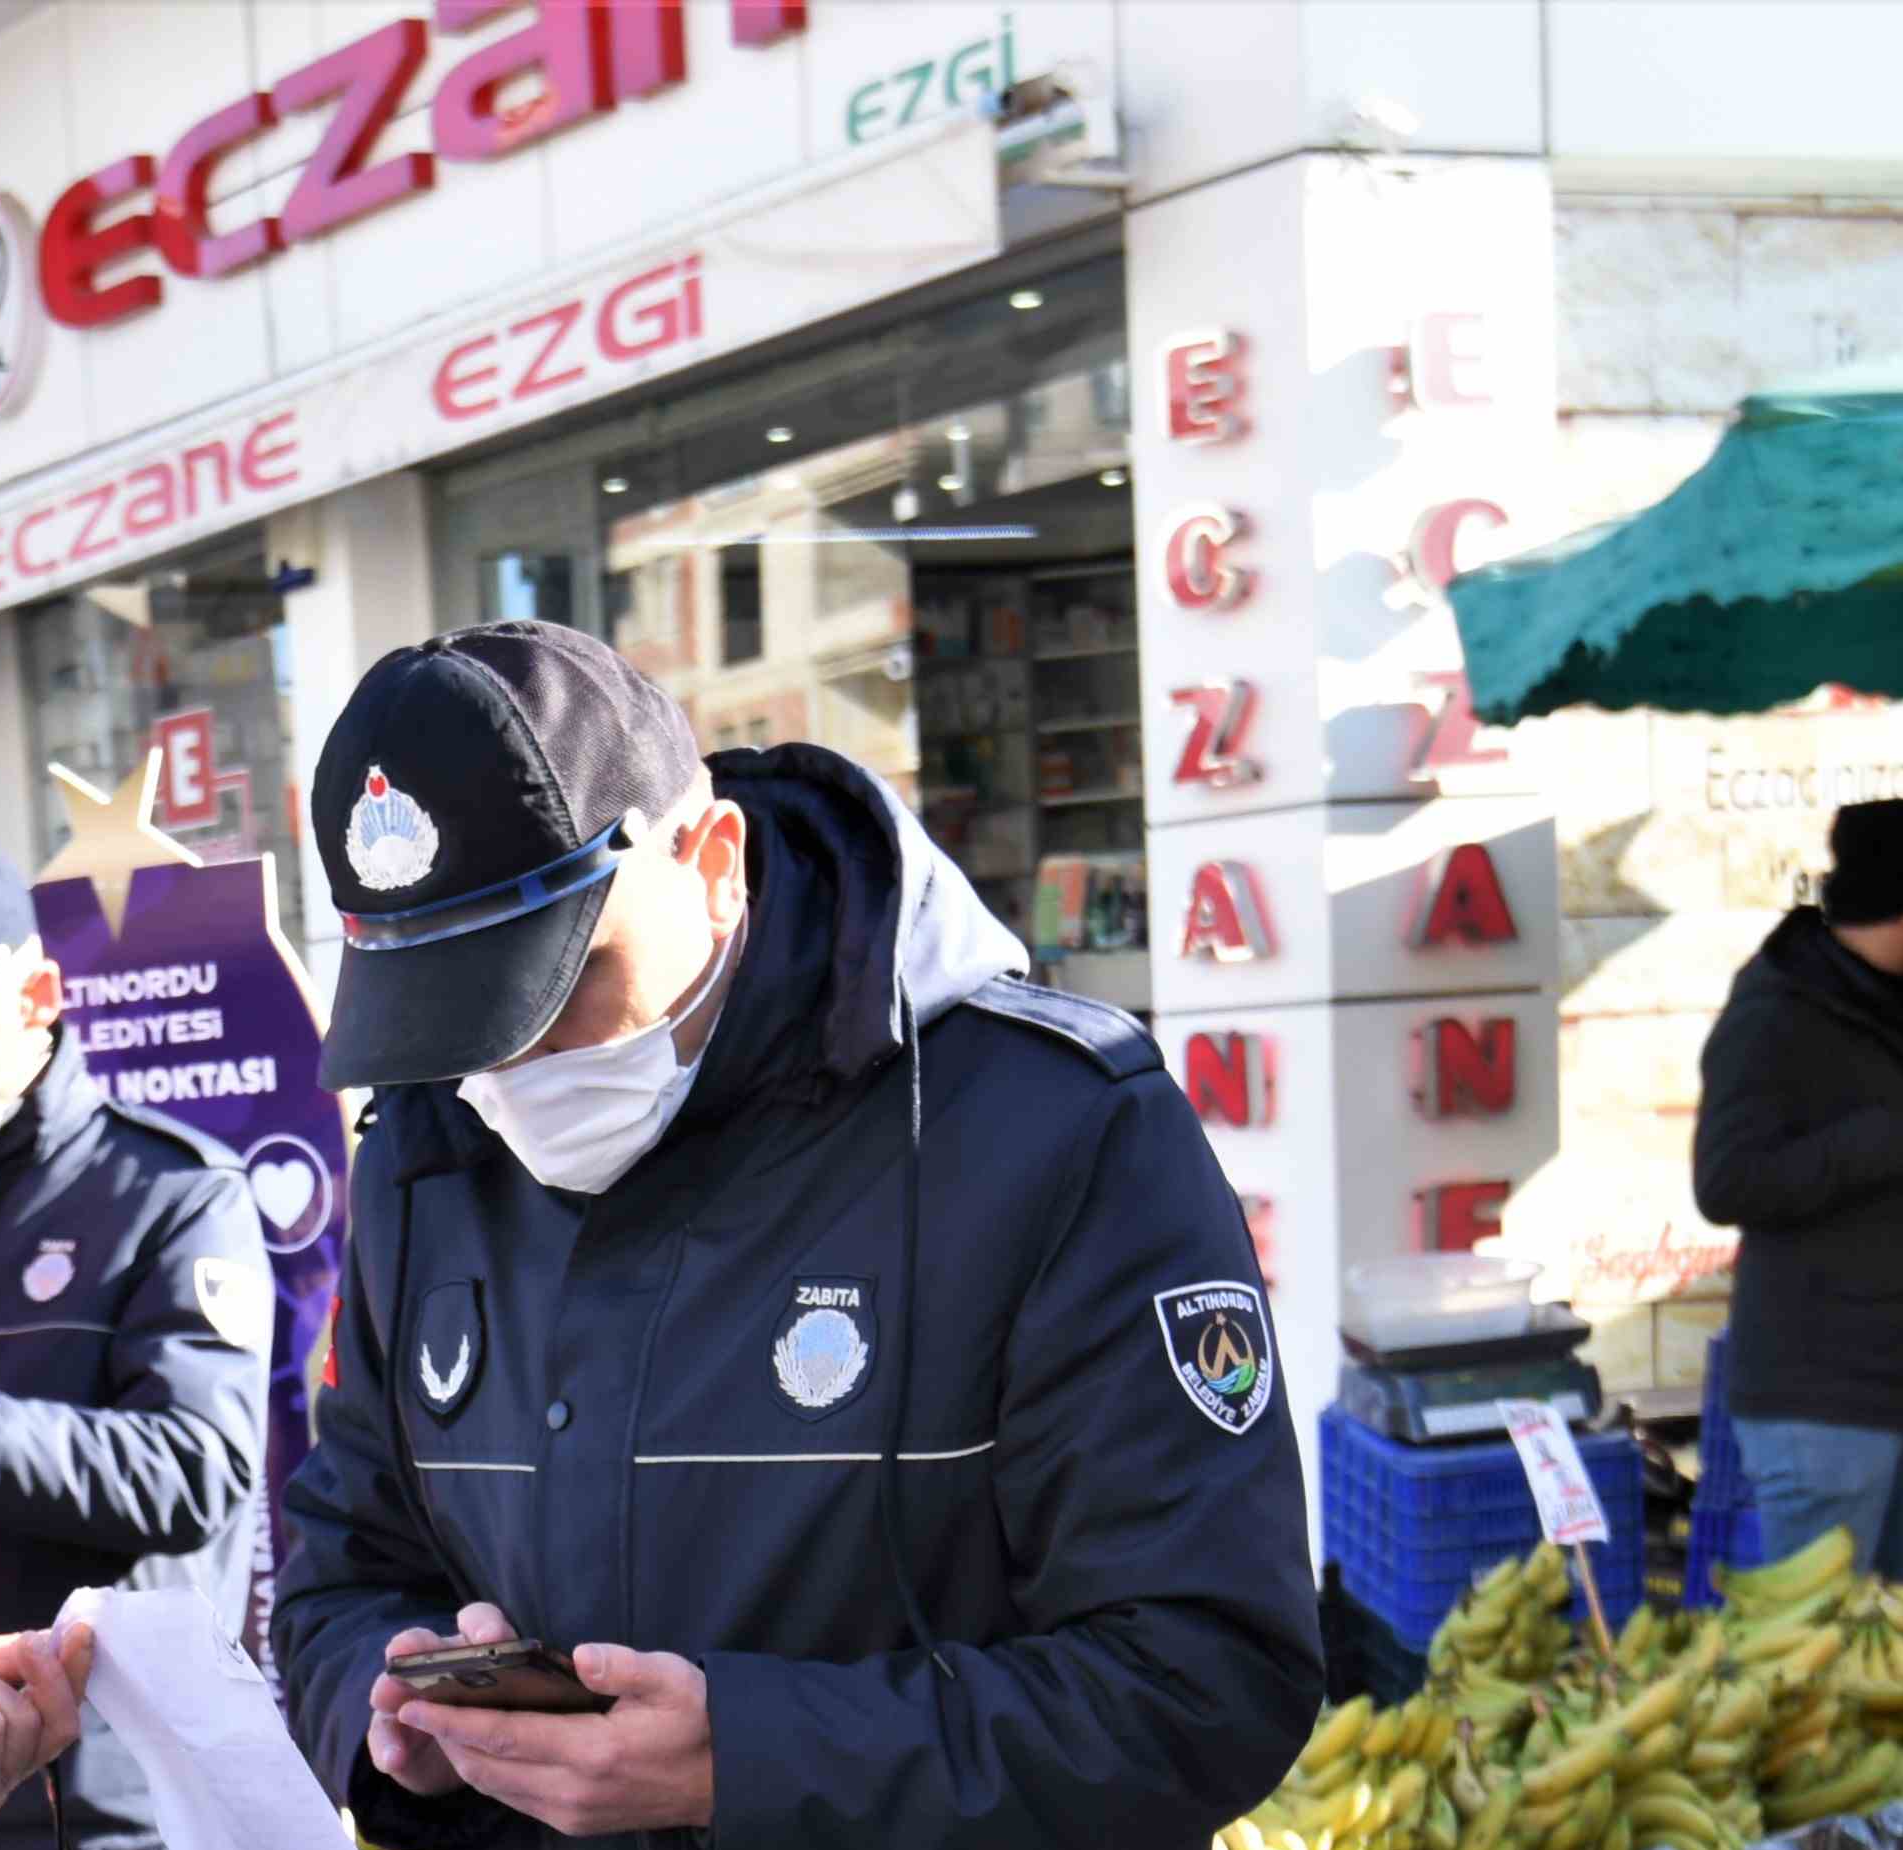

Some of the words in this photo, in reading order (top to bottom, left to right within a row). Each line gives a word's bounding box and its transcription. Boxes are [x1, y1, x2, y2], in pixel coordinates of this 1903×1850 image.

[60, 961, 218, 1009] LTINORDU
[115, 1055, 278, 1106] NOKTASI
[796, 1285, 860, 1307] ZABITA
[1176, 1291, 1254, 1320] ALTINORDU
